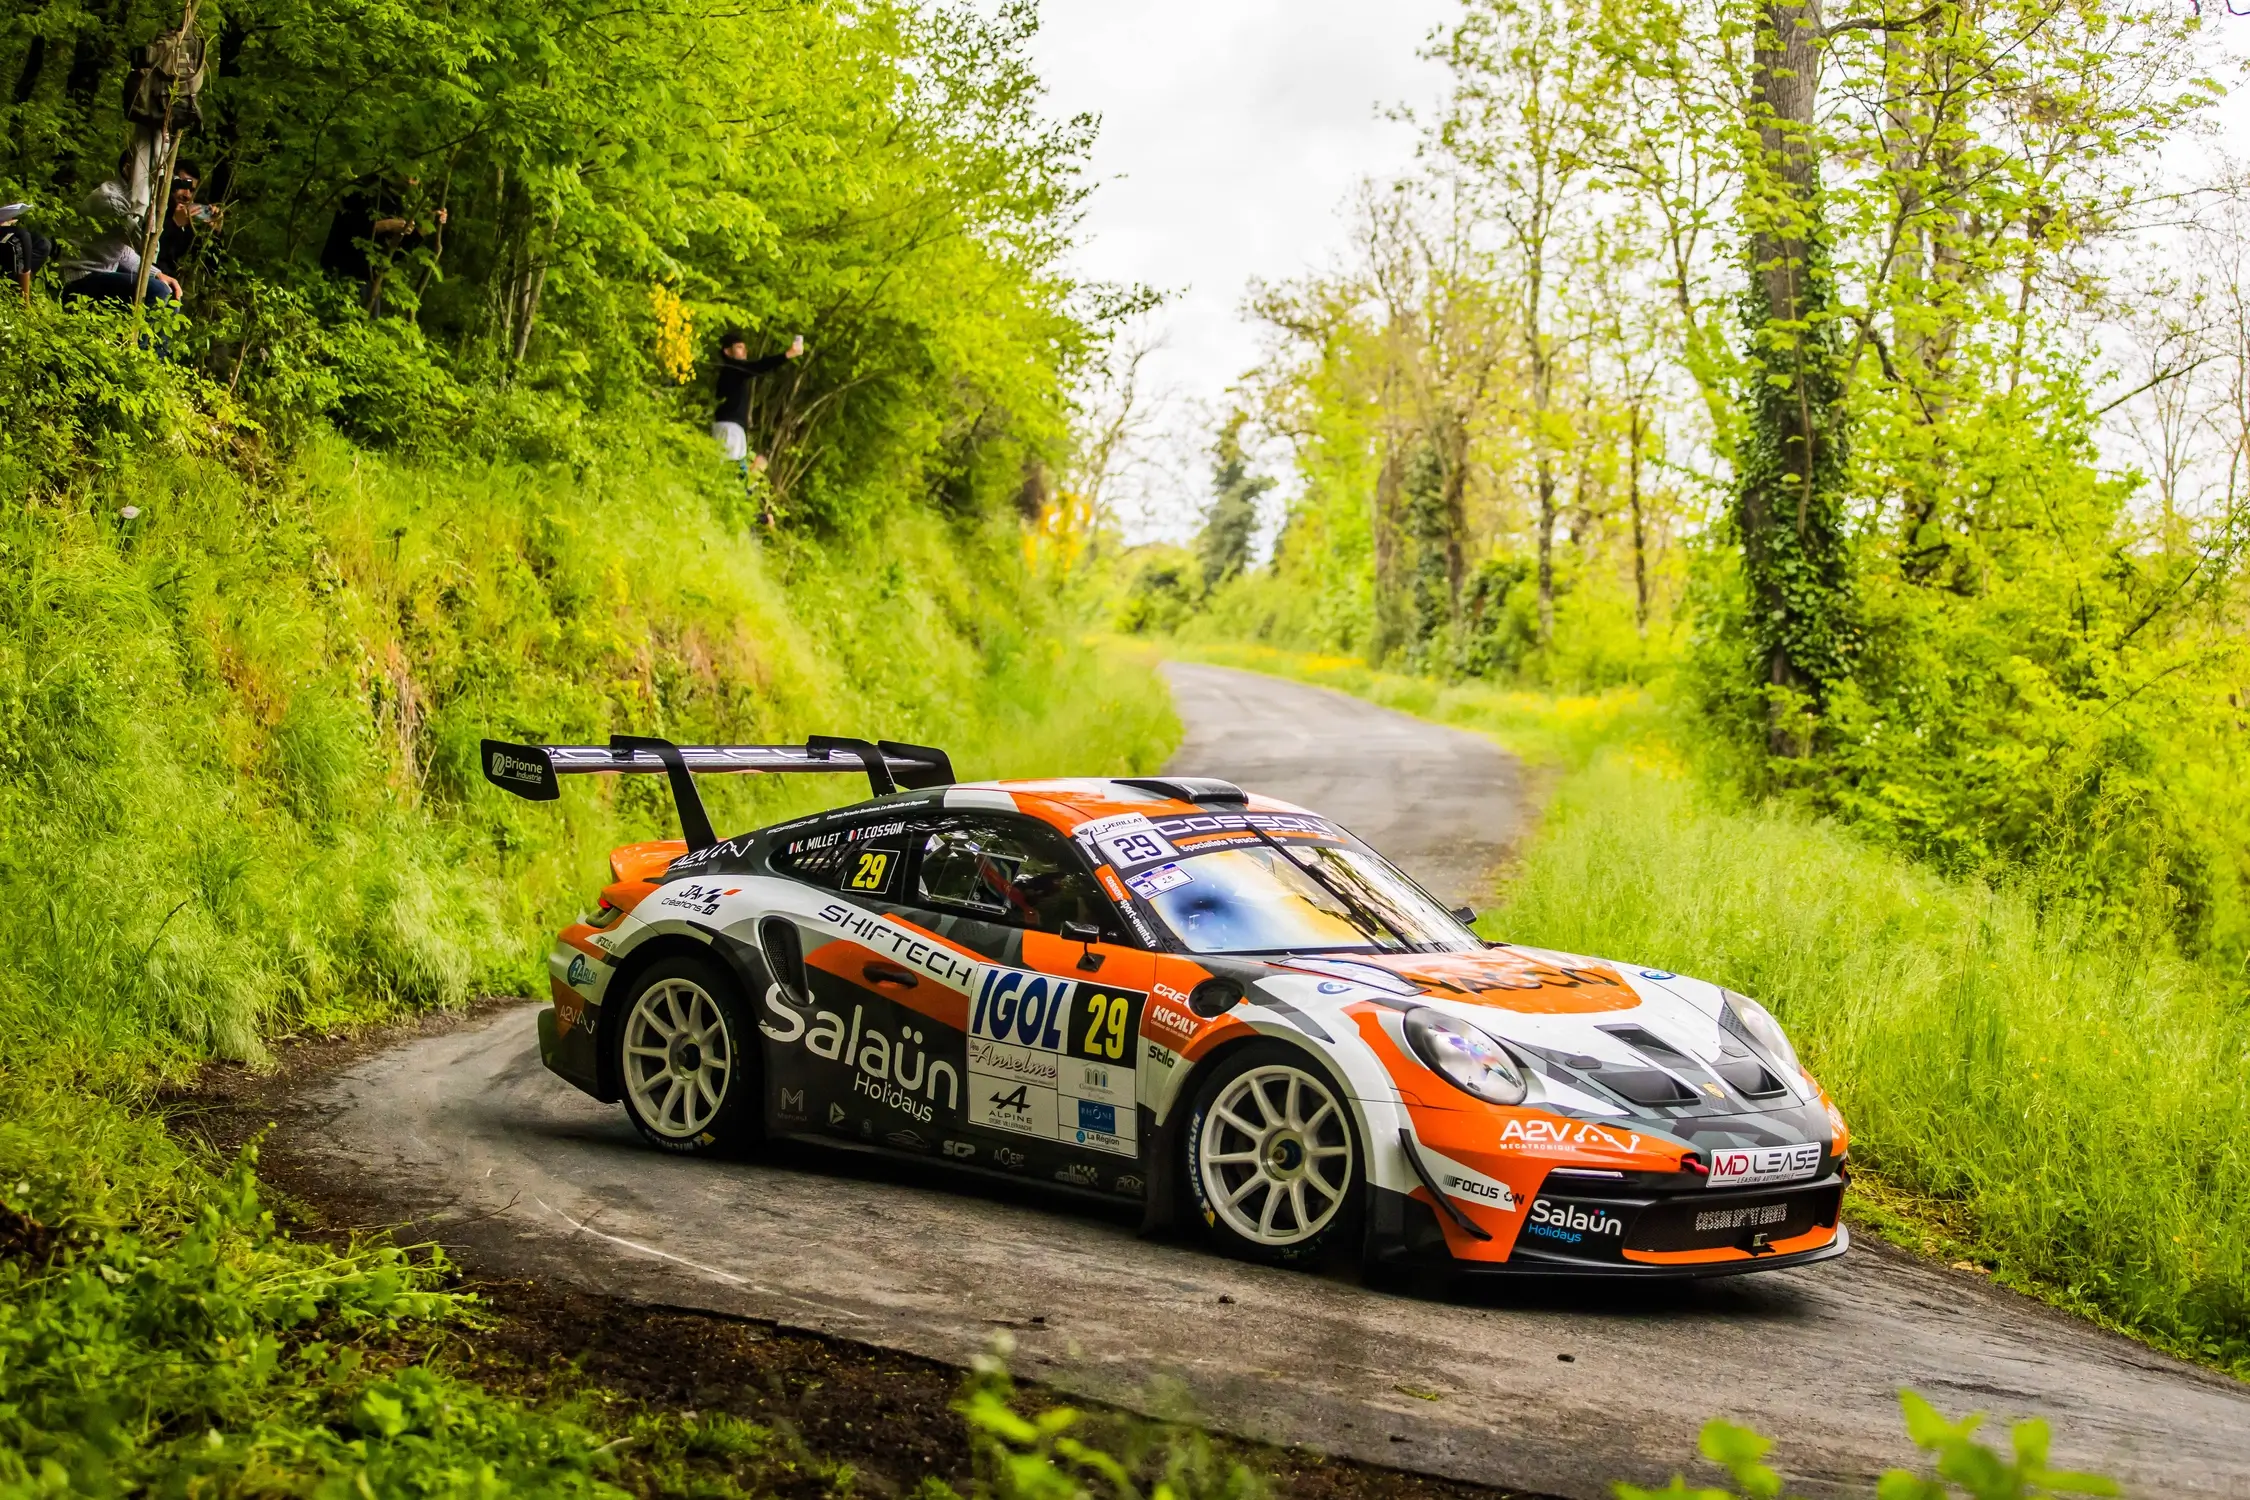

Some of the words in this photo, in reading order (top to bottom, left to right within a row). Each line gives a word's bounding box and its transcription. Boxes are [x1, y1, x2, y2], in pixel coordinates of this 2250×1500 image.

[505, 756, 542, 774] Brionne
[516, 772, 542, 782] Industrie
[766, 817, 820, 835] PORSCHE
[1156, 815, 1334, 836] COSSON
[796, 839, 804, 853] K.
[806, 832, 841, 850] MILLET
[1113, 834, 1162, 862] 29
[1229, 835, 1263, 847] Porsche
[851, 853, 888, 889] 29
[661, 897, 703, 913] Créations
[1105, 875, 1157, 949] cosson-sport-events.fr
[818, 904, 972, 986] SHIFTECH
[1153, 982, 1191, 1008] ORE
[972, 970, 1069, 1050] IGOL
[1084, 993, 1129, 1060] 29
[758, 982, 958, 1110] Salaün
[1149, 1045, 1175, 1069] Stilo
[971, 1043, 1057, 1079] Anselme
[854, 1072, 933, 1123] Holidays
[988, 1110, 1033, 1125] ALPINE
[1500, 1119, 1572, 1142] A2V
[1086, 1131, 1096, 1140] La
[1096, 1132, 1120, 1146] Région
[1187, 1111, 1202, 1198] MICHELIN
[1713, 1154, 1749, 1176] MD
[1753, 1149, 1819, 1174] LEASE
[1453, 1176, 1499, 1199] FOCUS
[1504, 1190, 1525, 1205] ON
[1736, 1175, 1762, 1184] LEASING
[1762, 1173, 1795, 1183] AUTOMOBILE
[1530, 1200, 1622, 1237] Salaün
[1528, 1223, 1582, 1243] Holidays
